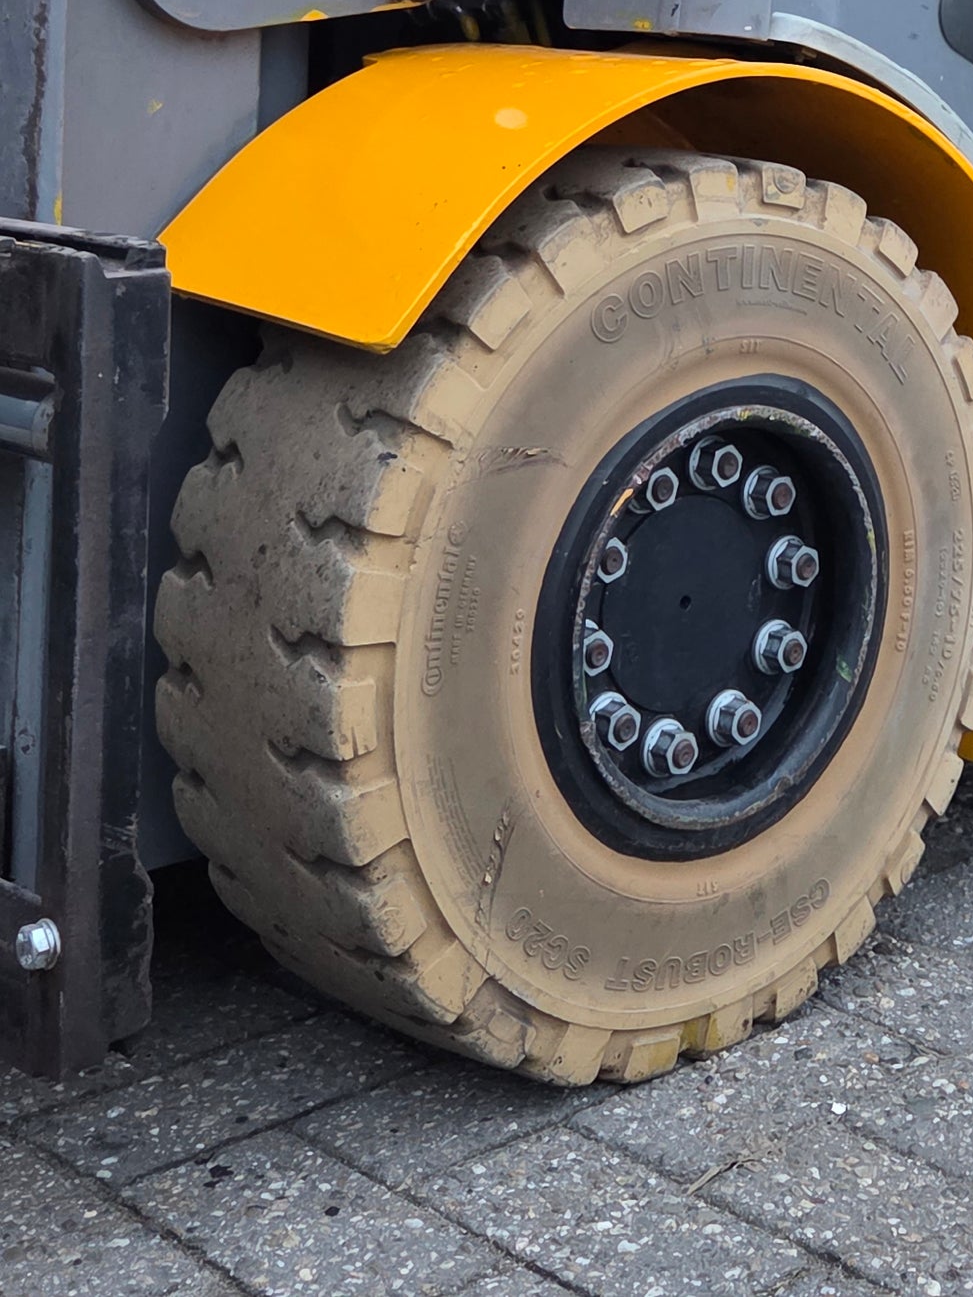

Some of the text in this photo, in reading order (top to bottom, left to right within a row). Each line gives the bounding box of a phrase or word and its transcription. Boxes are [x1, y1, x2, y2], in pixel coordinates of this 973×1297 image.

[590, 243, 916, 385] CONTINENTAL
[420, 546, 462, 697] Continental
[504, 906, 592, 981] SC20
